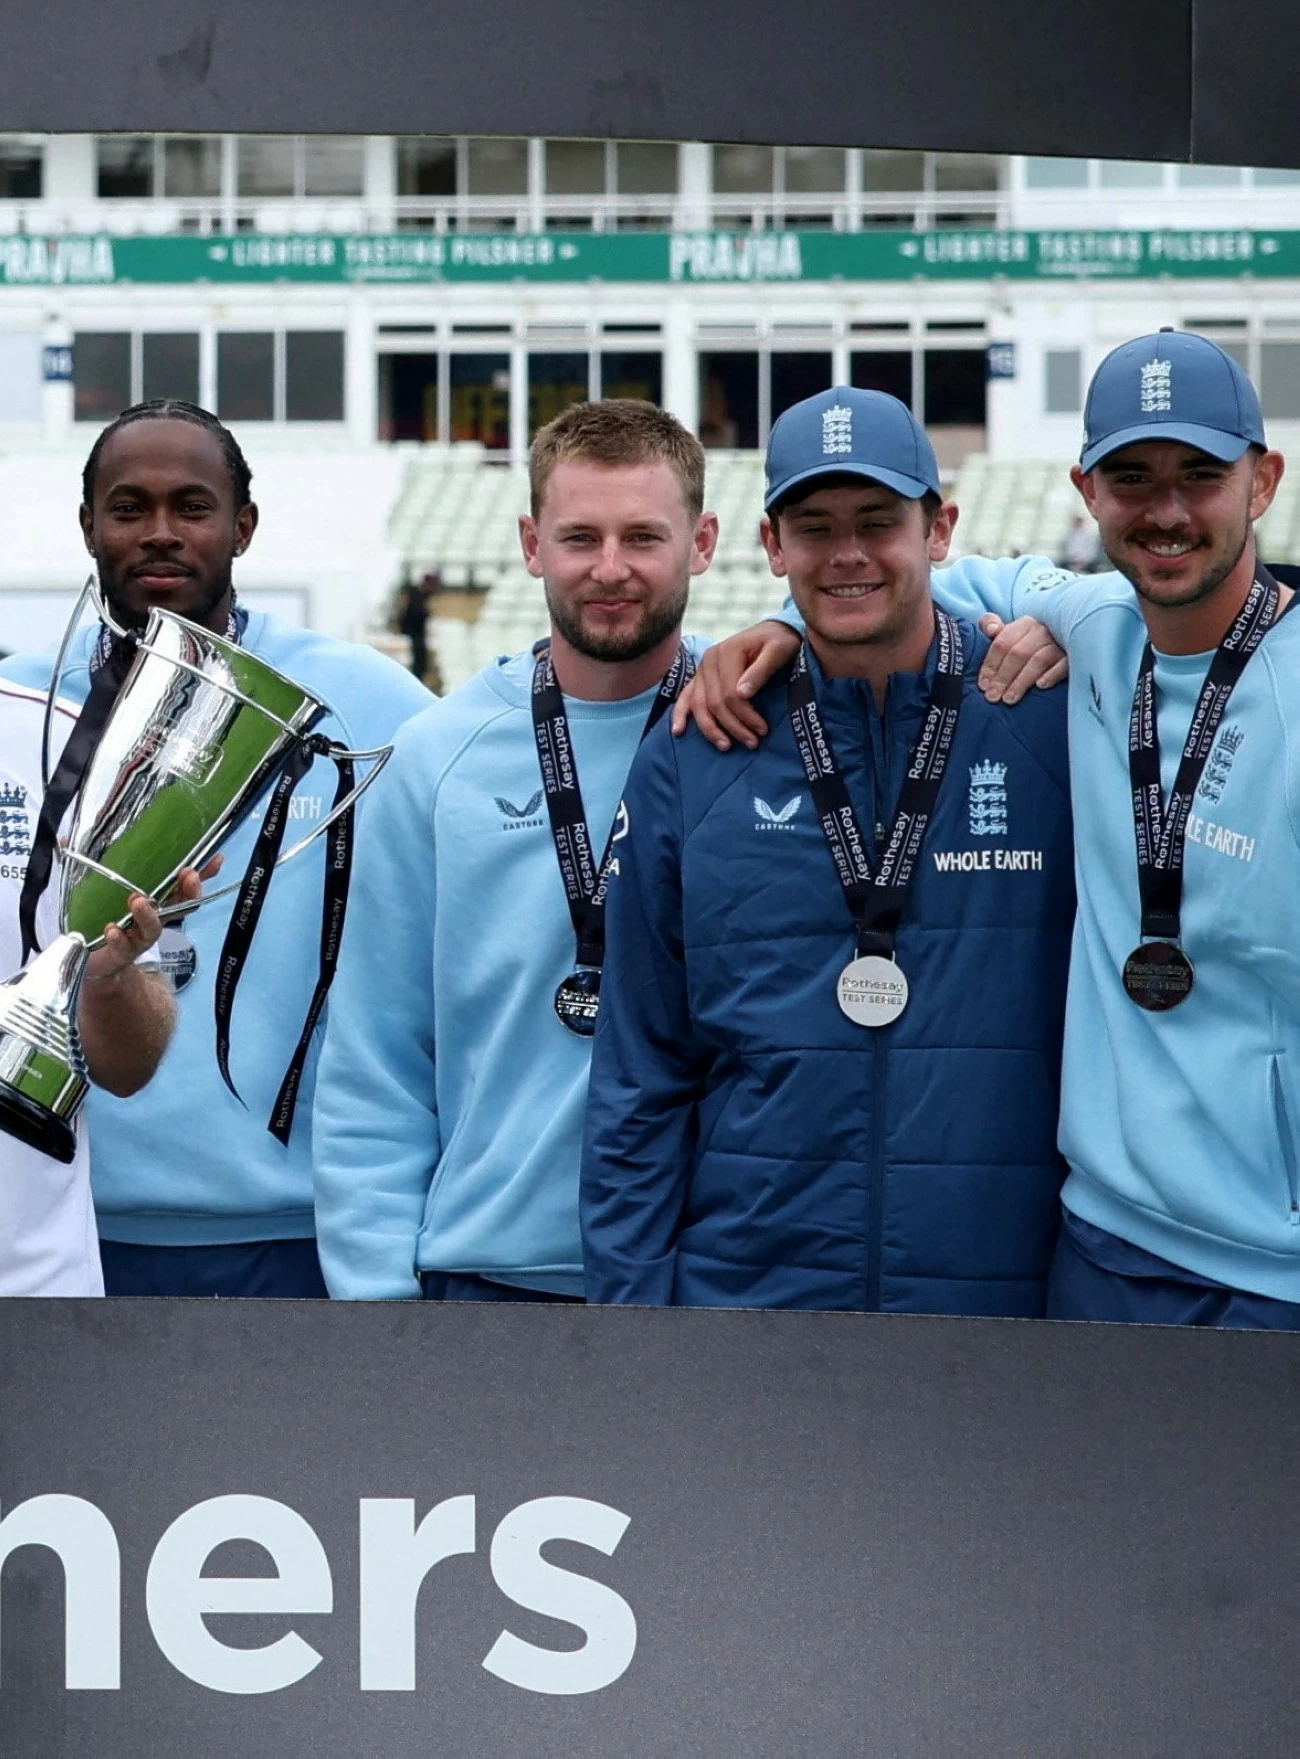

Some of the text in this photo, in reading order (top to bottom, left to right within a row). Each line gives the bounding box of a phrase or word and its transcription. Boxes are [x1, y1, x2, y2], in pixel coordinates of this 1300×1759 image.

[451, 239, 553, 265] PILSNER
[1149, 235, 1253, 261] PILSNER
[1224, 580, 1265, 650] Rothesay
[1244, 589, 1278, 652] TEST SERIES
[954, 650, 963, 676] TEST
[553, 717, 575, 789] Rothesay
[792, 710, 818, 781] TEST SERIES
[806, 702, 835, 775] Rothesay
[909, 704, 941, 779] Rothesay
[931, 709, 957, 781] TEST SERIES
[1131, 711, 1140, 751] SERIES
[1184, 681, 1216, 758] Rothesay
[1198, 685, 1231, 759] TEST SERIES
[536, 722, 557, 793] TEST SERIES
[290, 796, 320, 819] RTH
[503, 820, 544, 831] CASTORE
[1134, 788, 1148, 865] TEST SERIES
[1154, 792, 1181, 869] Rothesay
[1204, 822, 1255, 862] EARTH
[0, 865, 27, 880] 655
[556, 827, 578, 900] TEST SERIES
[822, 813, 853, 887] TEST SERIES
[839, 806, 871, 880] Rothesay
[875, 811, 910, 887] Rothesay
[897, 813, 927, 887] TEST SERIES
[933, 850, 1042, 872] WHOLE EARTH
[1172, 841, 1182, 869] TEST
[236, 866, 264, 929] Rothesay
[326, 898, 343, 960] Rothesay
[842, 977, 903, 993] Rothesay
[842, 993, 903, 1006] TEST SERIES
